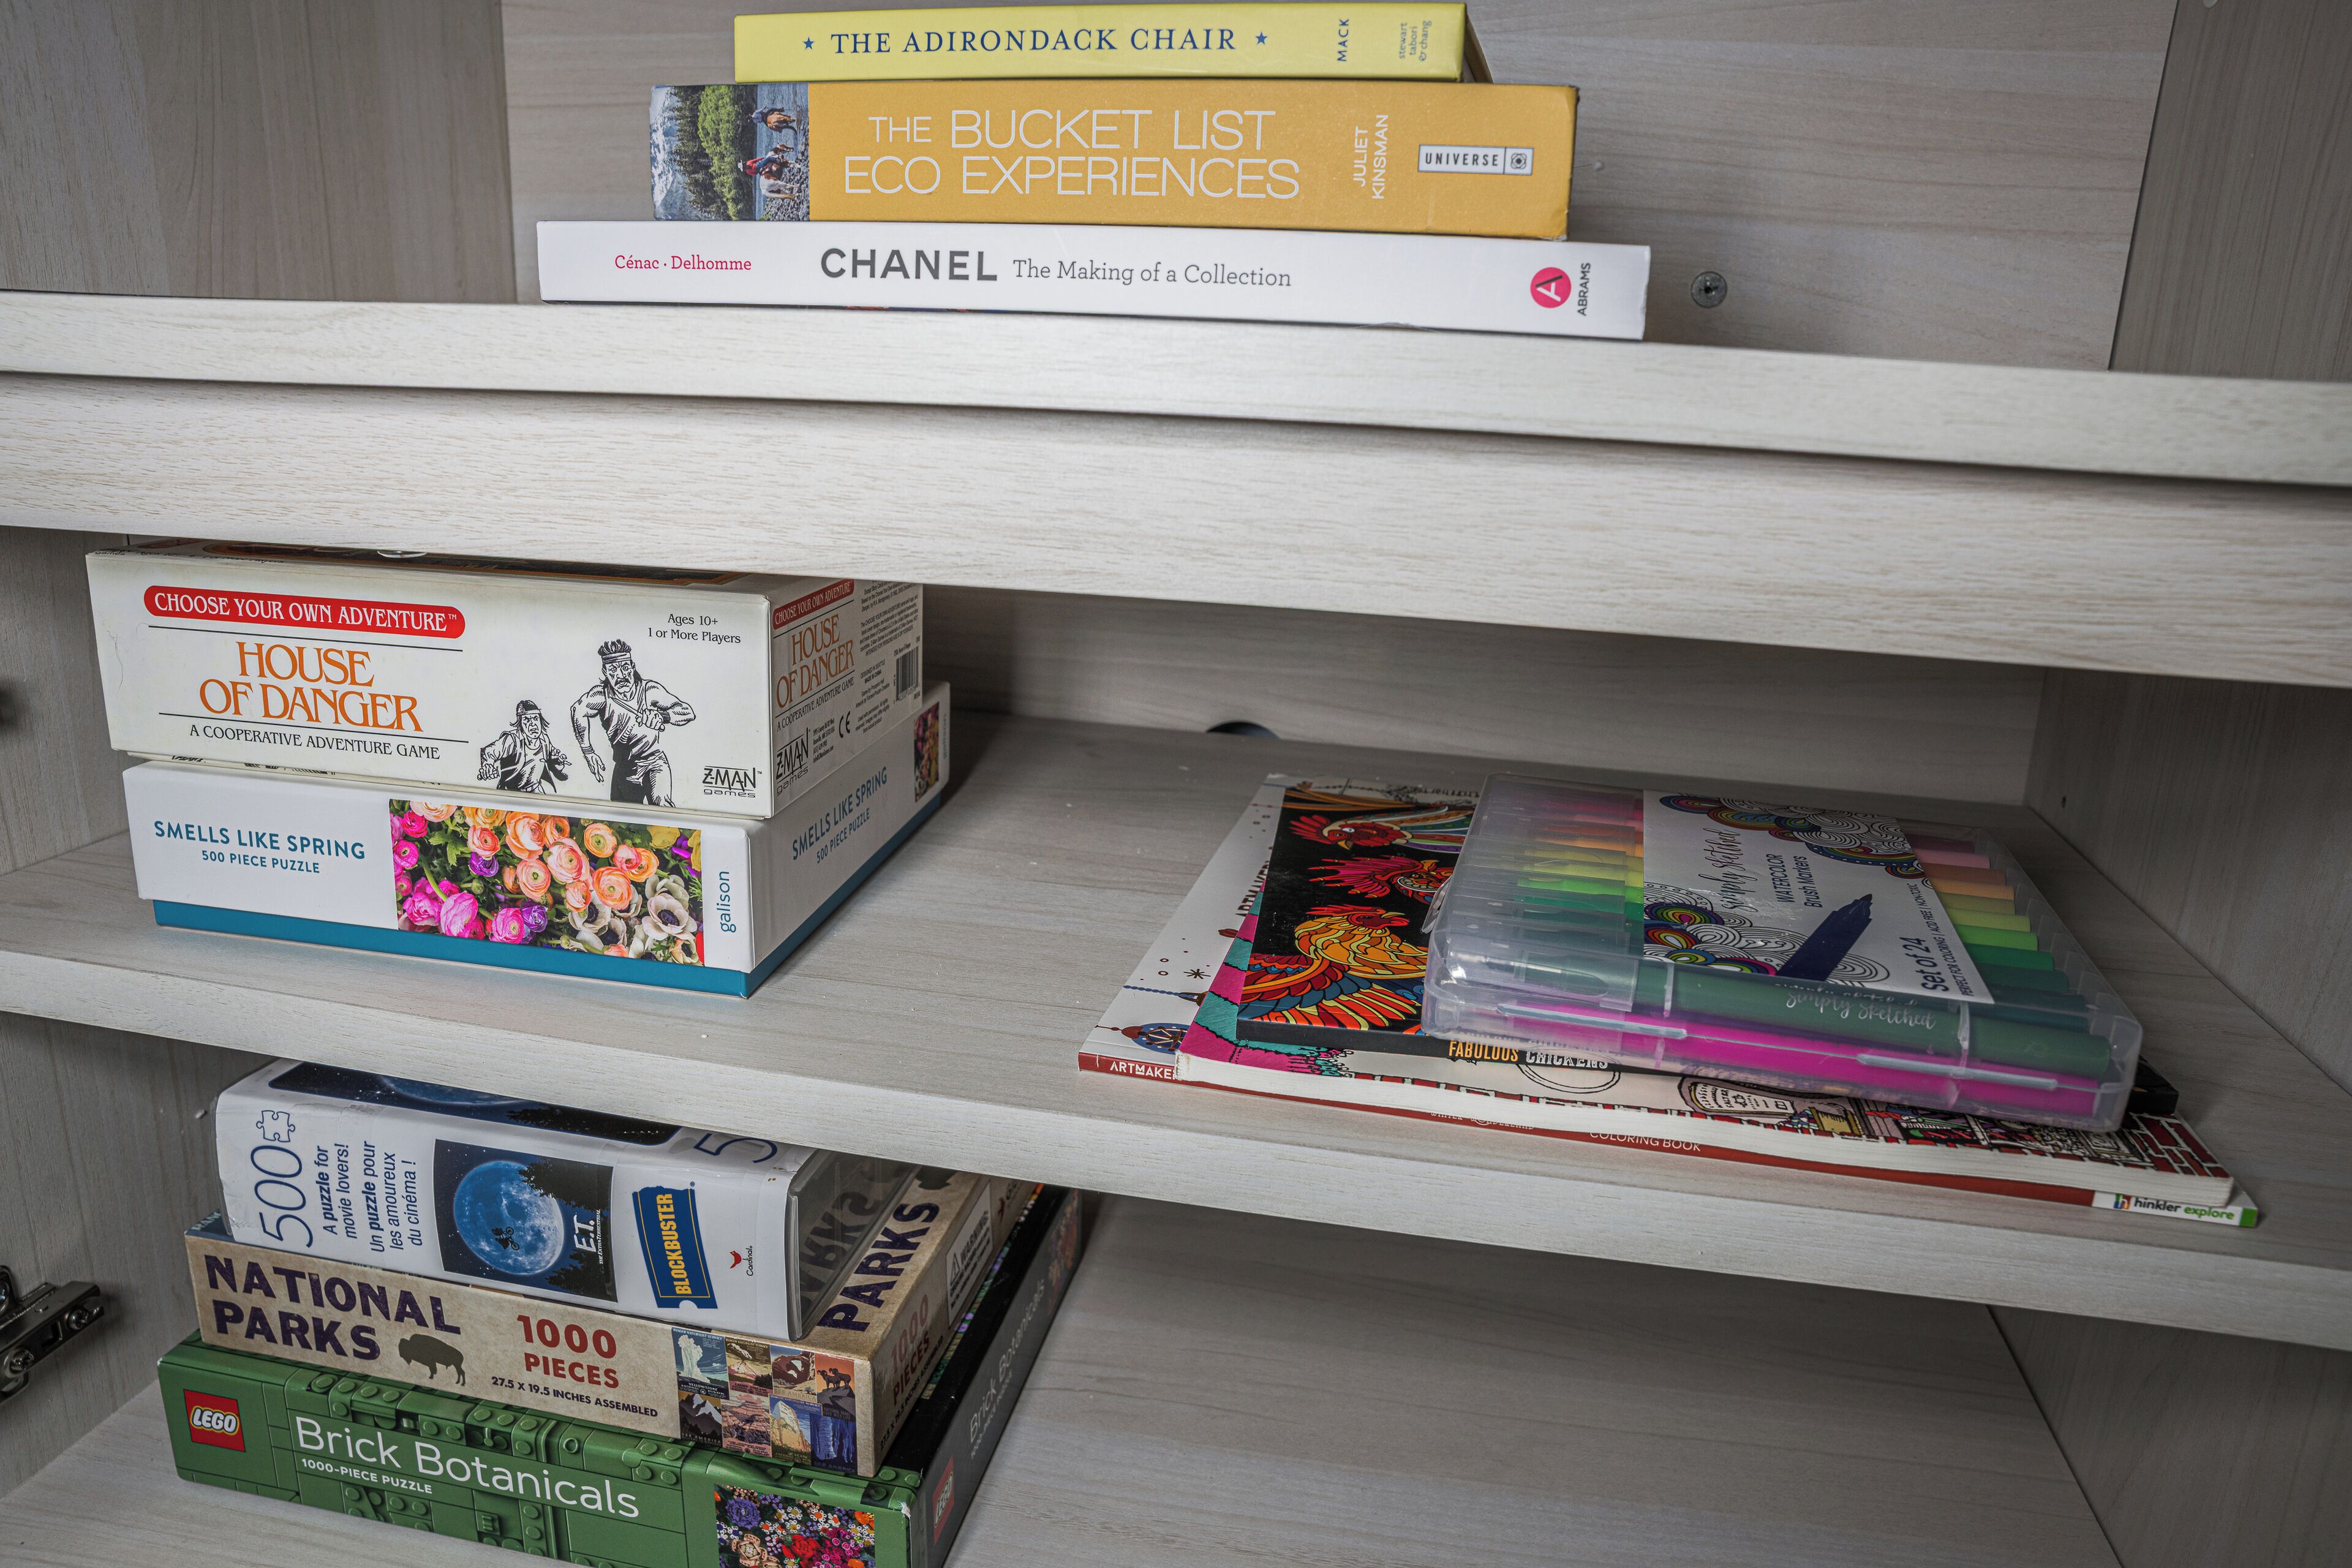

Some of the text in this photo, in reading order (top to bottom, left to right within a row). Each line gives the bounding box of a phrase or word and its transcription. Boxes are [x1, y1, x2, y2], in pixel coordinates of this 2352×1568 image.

[831, 28, 1235, 53] THE ADIRONDACK CHAIR
[1338, 18, 1349, 61] MACK
[1399, 23, 1408, 59] stewart
[1422, 20, 1431, 49] chang
[868, 110, 1276, 150] THE BUCKET LIST
[845, 156, 1299, 199] ECO EXPERIENCES
[1353, 126, 1368, 187] JULIET
[1371, 115, 1389, 199] KINSMAN
[1425, 153, 1498, 166] UNIVERSE
[614, 255, 752, 271] Cénac Delhomme
[821, 248, 1291, 287] CHANEL The Making of a Collection
[1577, 263, 1591, 316] ABRAMS
[154, 592, 230, 616] CHOOSE
[234, 598, 284, 620] YOUR
[289, 603, 331, 623] OWN
[668, 614, 718, 627] Ages 10+
[775, 607, 797, 625] CHOOSE
[796, 600, 811, 614] YOUR
[812, 594, 824, 608] OWN
[648, 628, 652, 638] 1
[671, 630, 698, 640] More
[702, 631, 741, 644] Players
[791, 614, 840, 666] HOUSE
[236, 641, 375, 687] HOUSE
[776, 671, 797, 709] OF
[800, 639, 855, 696] DANGER
[200, 679, 423, 732] OF DANGER
[777, 722, 782, 732] A
[782, 701, 815, 728] COOPERATIVE
[815, 685, 841, 708] ADVENTURE
[842, 677, 854, 691] GAME
[190, 725, 440, 760] A COOPERATIVE ADVENTURE GAME
[703, 789, 755, 797] games
[777, 766, 809, 796] games
[793, 767, 887, 860] SMELLS LIKE SPRING
[817, 808, 870, 864] 500 PIECE PUZZLE
[154, 821, 365, 859] SMELLS LIKE SPRING
[202, 850, 320, 873] 500 PIECE PUZZLE
[717, 871, 736, 933] galison
[1766, 854, 1795, 902] WATERCOLOR
[1792, 856, 1822, 908] Brush Markers
[1907, 883, 1974, 996] PERFECT FOR COLORING ACID FREE NON-TOXIC
[1899, 937, 1950, 992] Set of 24
[1663, 1138, 1701, 1152] BOOK
[251, 1145, 314, 1248] 500
[315, 1145, 337, 1235] A puzzle for
[334, 1143, 358, 1239] movie lovers!
[362, 1141, 385, 1253] Un puzzle pour
[383, 1152, 404, 1250] les amoureux
[401, 1171, 423, 1246] du cinéma
[2134, 1197, 2181, 1213] hinkler
[2184, 1205, 2234, 1219] explore
[573, 1215, 597, 1253] E.T.
[656, 1193, 692, 1295] BLOCKBUSTER
[816, 1202, 940, 1332] PARKS
[204, 1254, 461, 1335] NATIONAL
[212, 1299, 380, 1360] PARKS
[516, 1314, 617, 1359] 1000
[891, 1294, 929, 1374] 1000
[524, 1352, 619, 1389] PIECES
[893, 1330, 930, 1406] PIECES
[193, 1408, 238, 1433] LEGO
[492, 1376, 658, 1417] 27.5 X 19.5 INCHES ASSEMBLED
[970, 1378, 997, 1443] Brick
[295, 1416, 639, 1518] Brick Botanicals
[301, 1458, 432, 1494] 1000-PIECE PUZZLE
